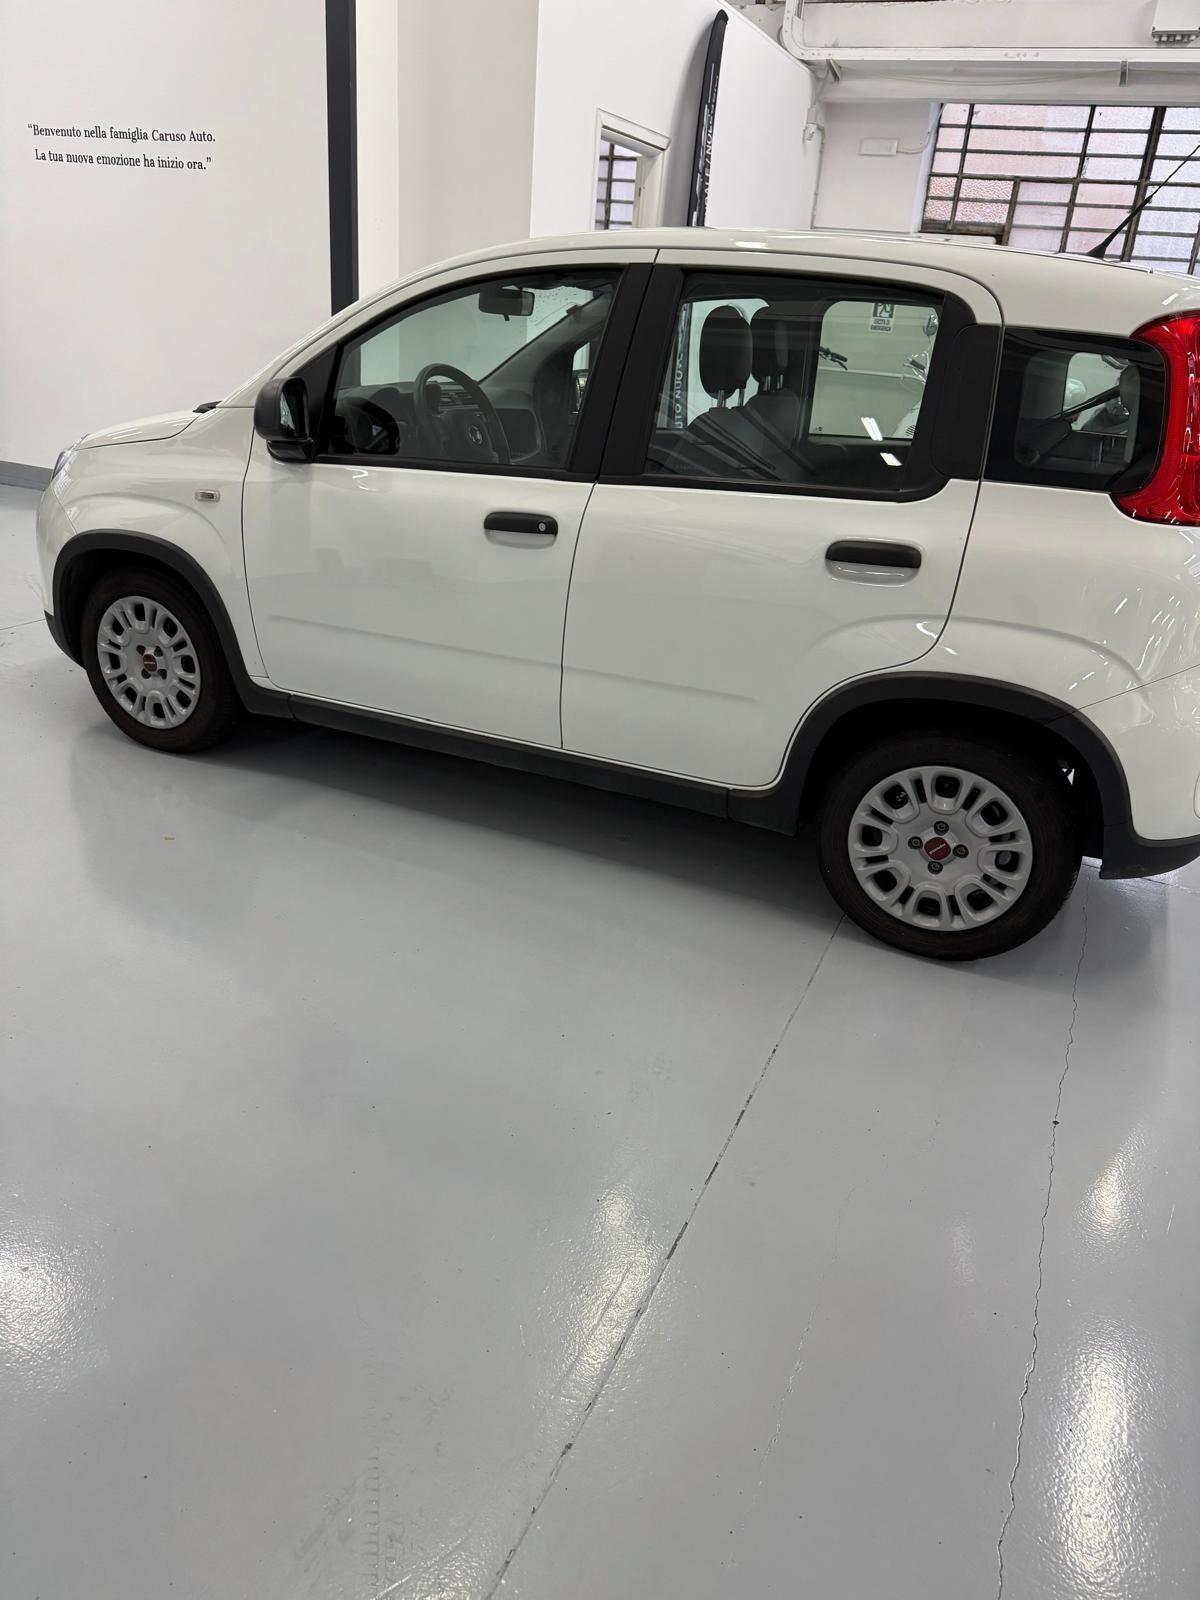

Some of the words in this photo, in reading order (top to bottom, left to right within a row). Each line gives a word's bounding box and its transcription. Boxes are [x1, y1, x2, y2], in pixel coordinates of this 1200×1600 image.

[28, 124, 82, 138] “Benvenuto
[84, 126, 107, 139] nella
[109, 127, 148, 144] famiglia
[152, 130, 186, 142] Caruso
[189, 130, 216, 142] Auto.
[35, 148, 46, 161] La
[48, 151, 64, 162] tua
[66, 153, 94, 164] nuova
[97, 154, 140, 167] emozione
[143, 154, 154, 168] ha
[157, 156, 184, 169] inizio
[187, 157, 212, 170] ora.”
[674, 404, 683, 428] UTO
